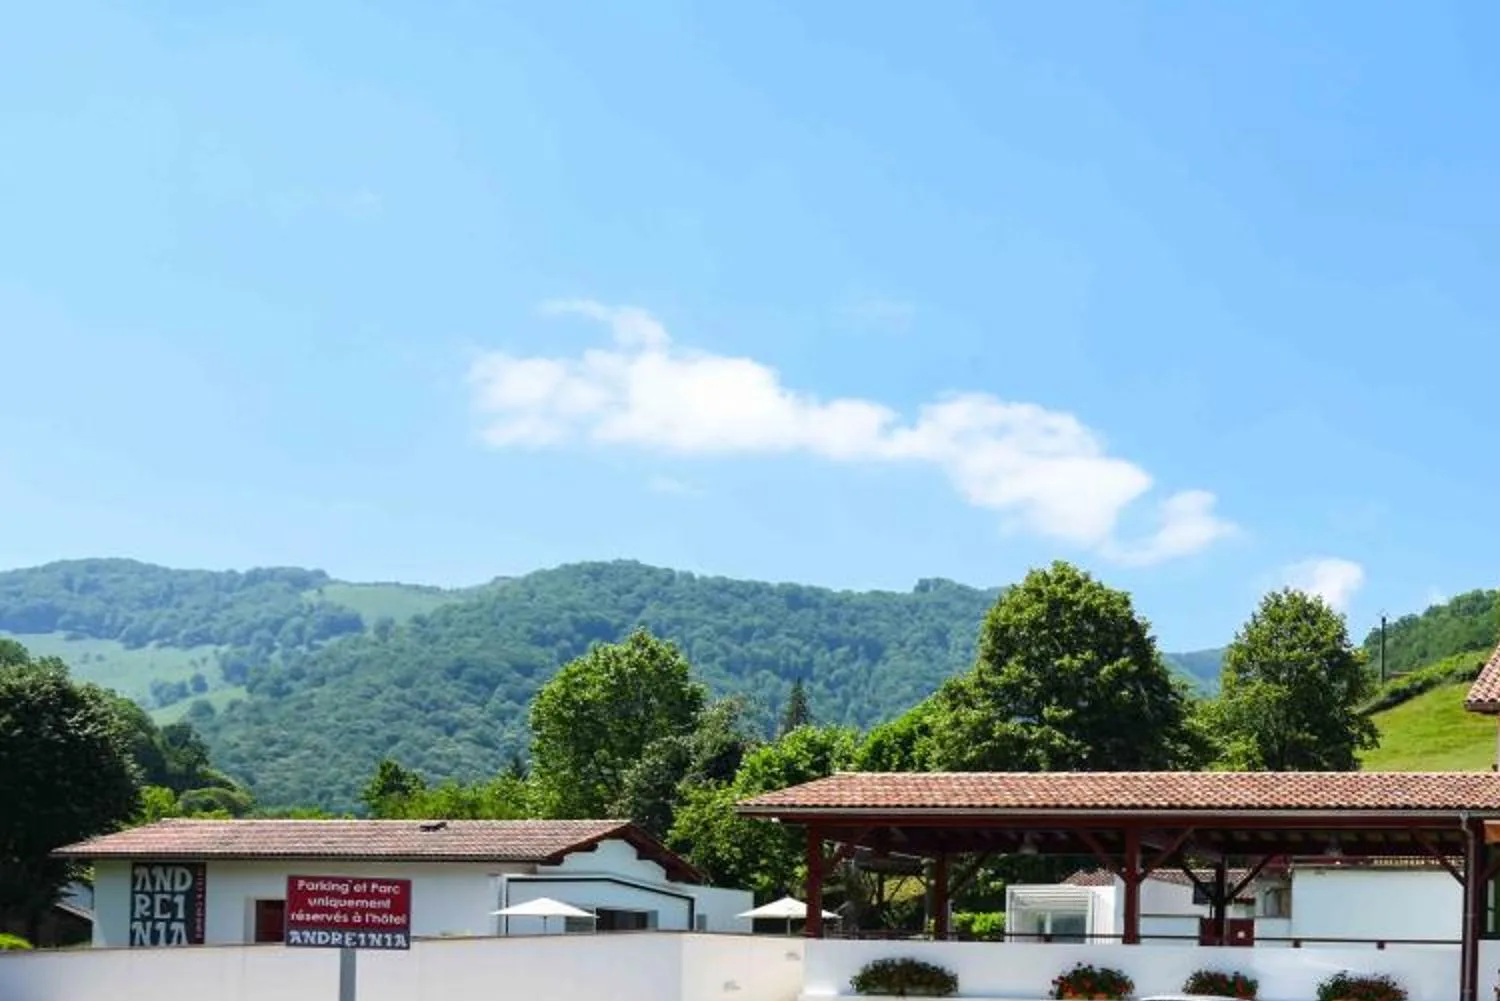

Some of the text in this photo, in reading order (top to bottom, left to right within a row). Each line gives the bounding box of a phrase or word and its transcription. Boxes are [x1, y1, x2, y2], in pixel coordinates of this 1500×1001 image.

[134, 865, 193, 892] AND
[297, 880, 400, 894] Parking et Parc
[307, 896, 391, 909] uniquement
[291, 909, 406, 925] réservés à l'hôtel
[131, 921, 189, 947] NIA
[288, 930, 408, 947] ANDREINIA
